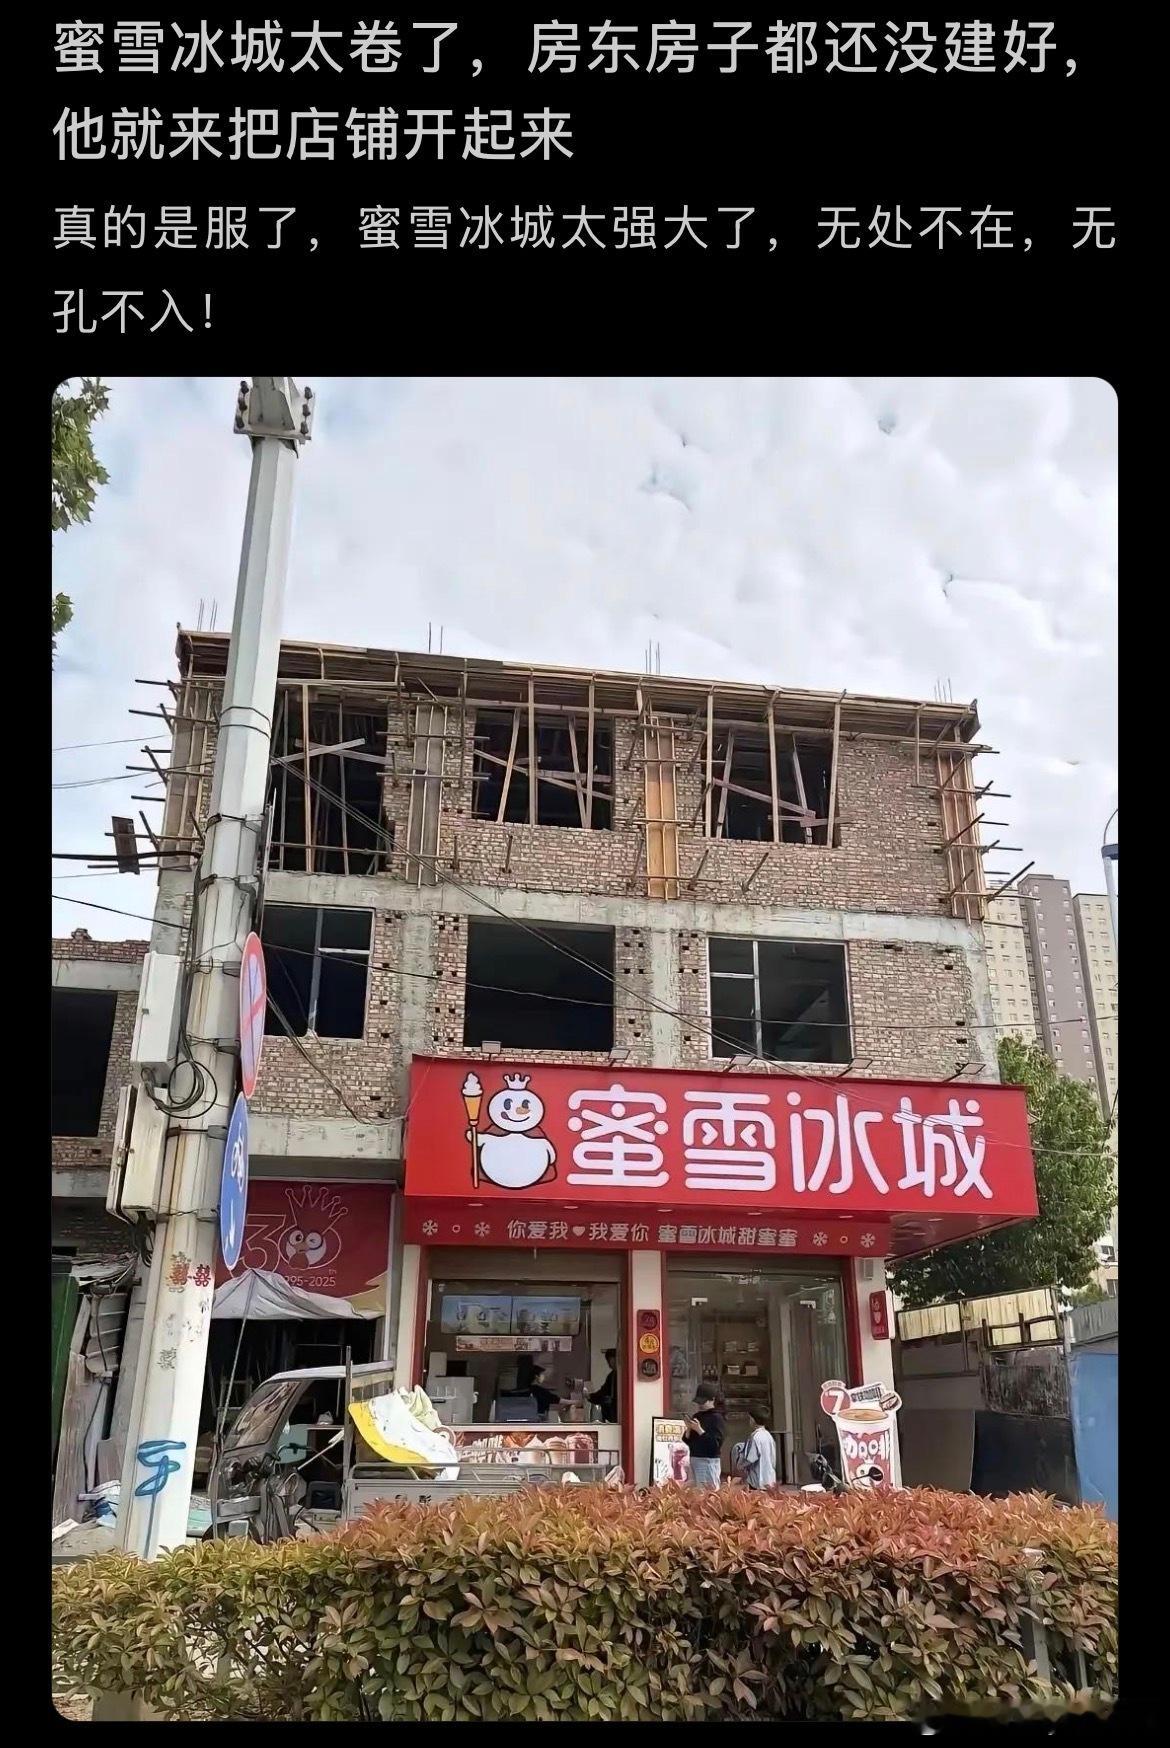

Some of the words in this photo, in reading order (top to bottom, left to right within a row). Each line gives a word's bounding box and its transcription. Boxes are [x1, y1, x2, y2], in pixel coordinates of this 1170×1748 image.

[567, 1083, 994, 1199] 蜜雪冰城
[507, 1220, 568, 1240] 你爱我
[589, 1222, 649, 1242] 我爱你
[657, 1224, 799, 1247] 蜜雪冰城甜蜜蜜
